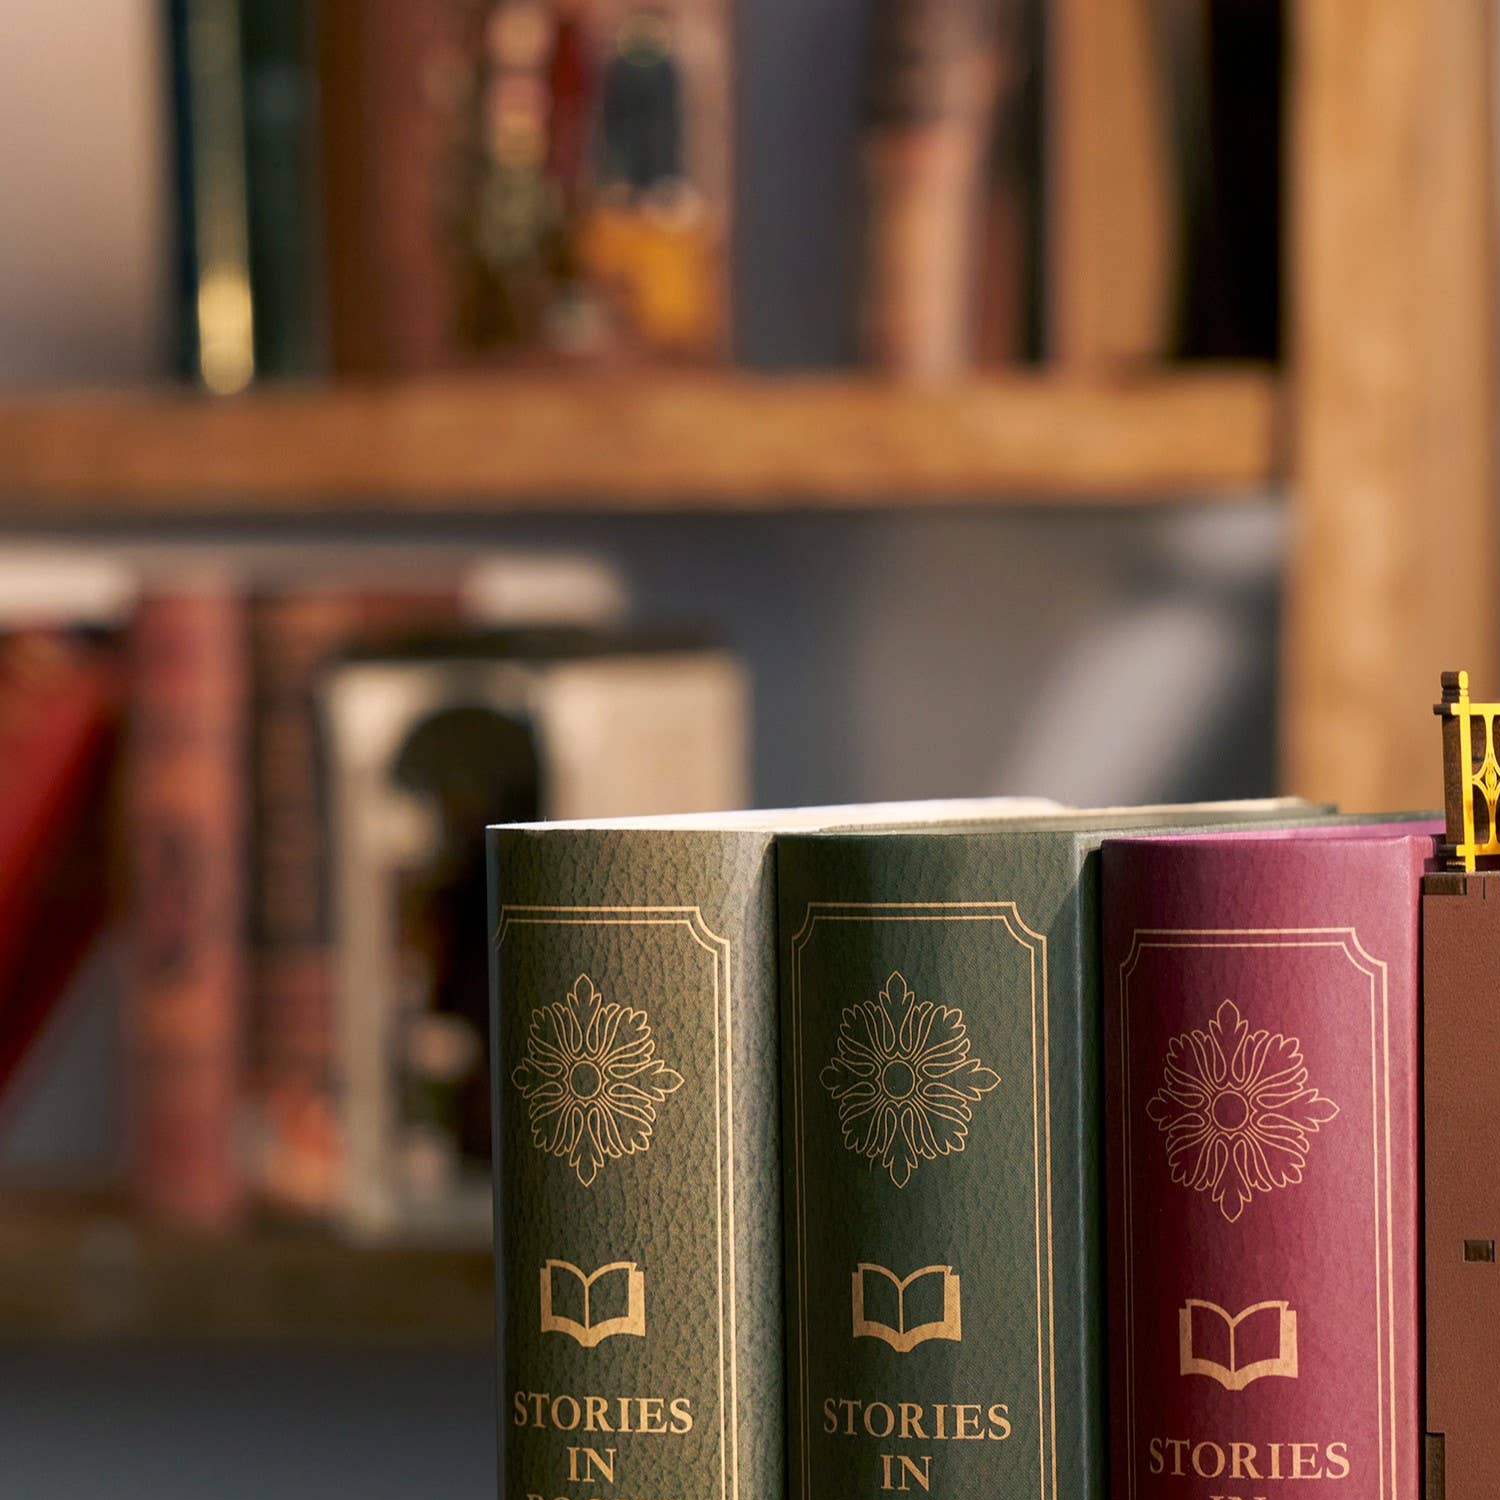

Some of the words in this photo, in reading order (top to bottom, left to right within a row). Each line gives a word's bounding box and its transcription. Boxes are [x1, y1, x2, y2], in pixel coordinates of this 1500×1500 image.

[513, 1390, 694, 1435] STORIES
[823, 1398, 1012, 1441] STORIES
[567, 1446, 616, 1483] IN
[880, 1454, 932, 1491] IN
[1150, 1437, 1350, 1480] STORIES
